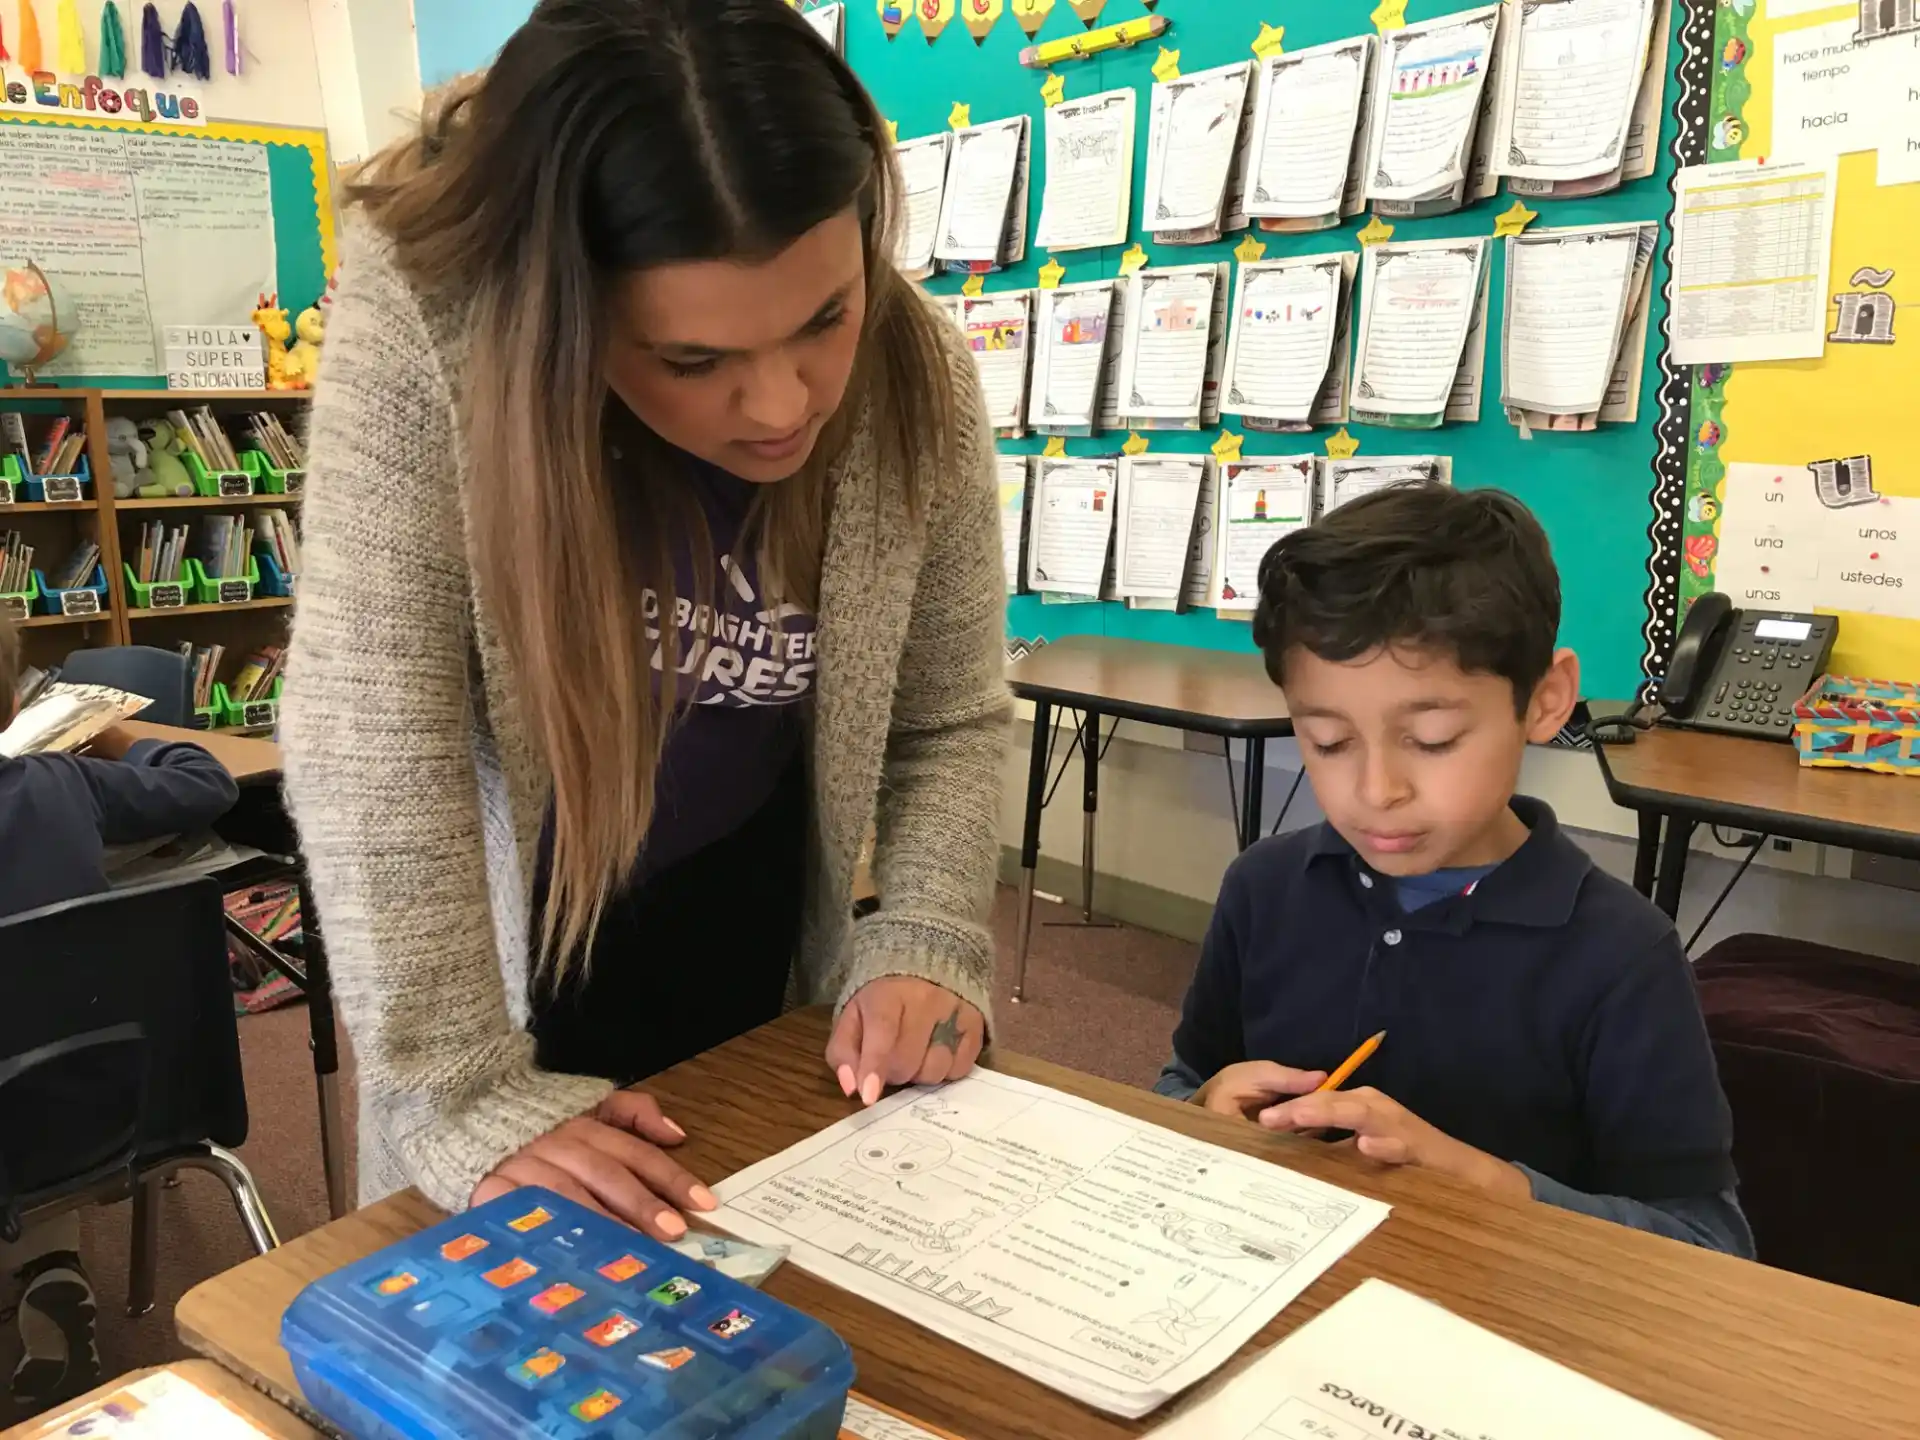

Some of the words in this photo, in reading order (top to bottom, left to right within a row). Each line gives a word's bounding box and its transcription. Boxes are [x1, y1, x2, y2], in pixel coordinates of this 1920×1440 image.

[1783, 50, 1819, 65] hace
[1802, 64, 1850, 82] tiempo
[33, 71, 200, 122] Enfoque
[1801, 112, 1849, 129] hacia
[1828, 266, 1896, 344] ñ
[186, 330, 238, 346] HOLA
[186, 351, 244, 367] SUPER
[168, 372, 264, 388] ESTUDIANTES
[1807, 454, 1881, 510] u
[1765, 491, 1784, 504] un
[1858, 527, 1897, 541] unos
[1754, 536, 1784, 549] una
[1840, 571, 1903, 589] ustedes
[1745, 587, 1781, 601] unas
